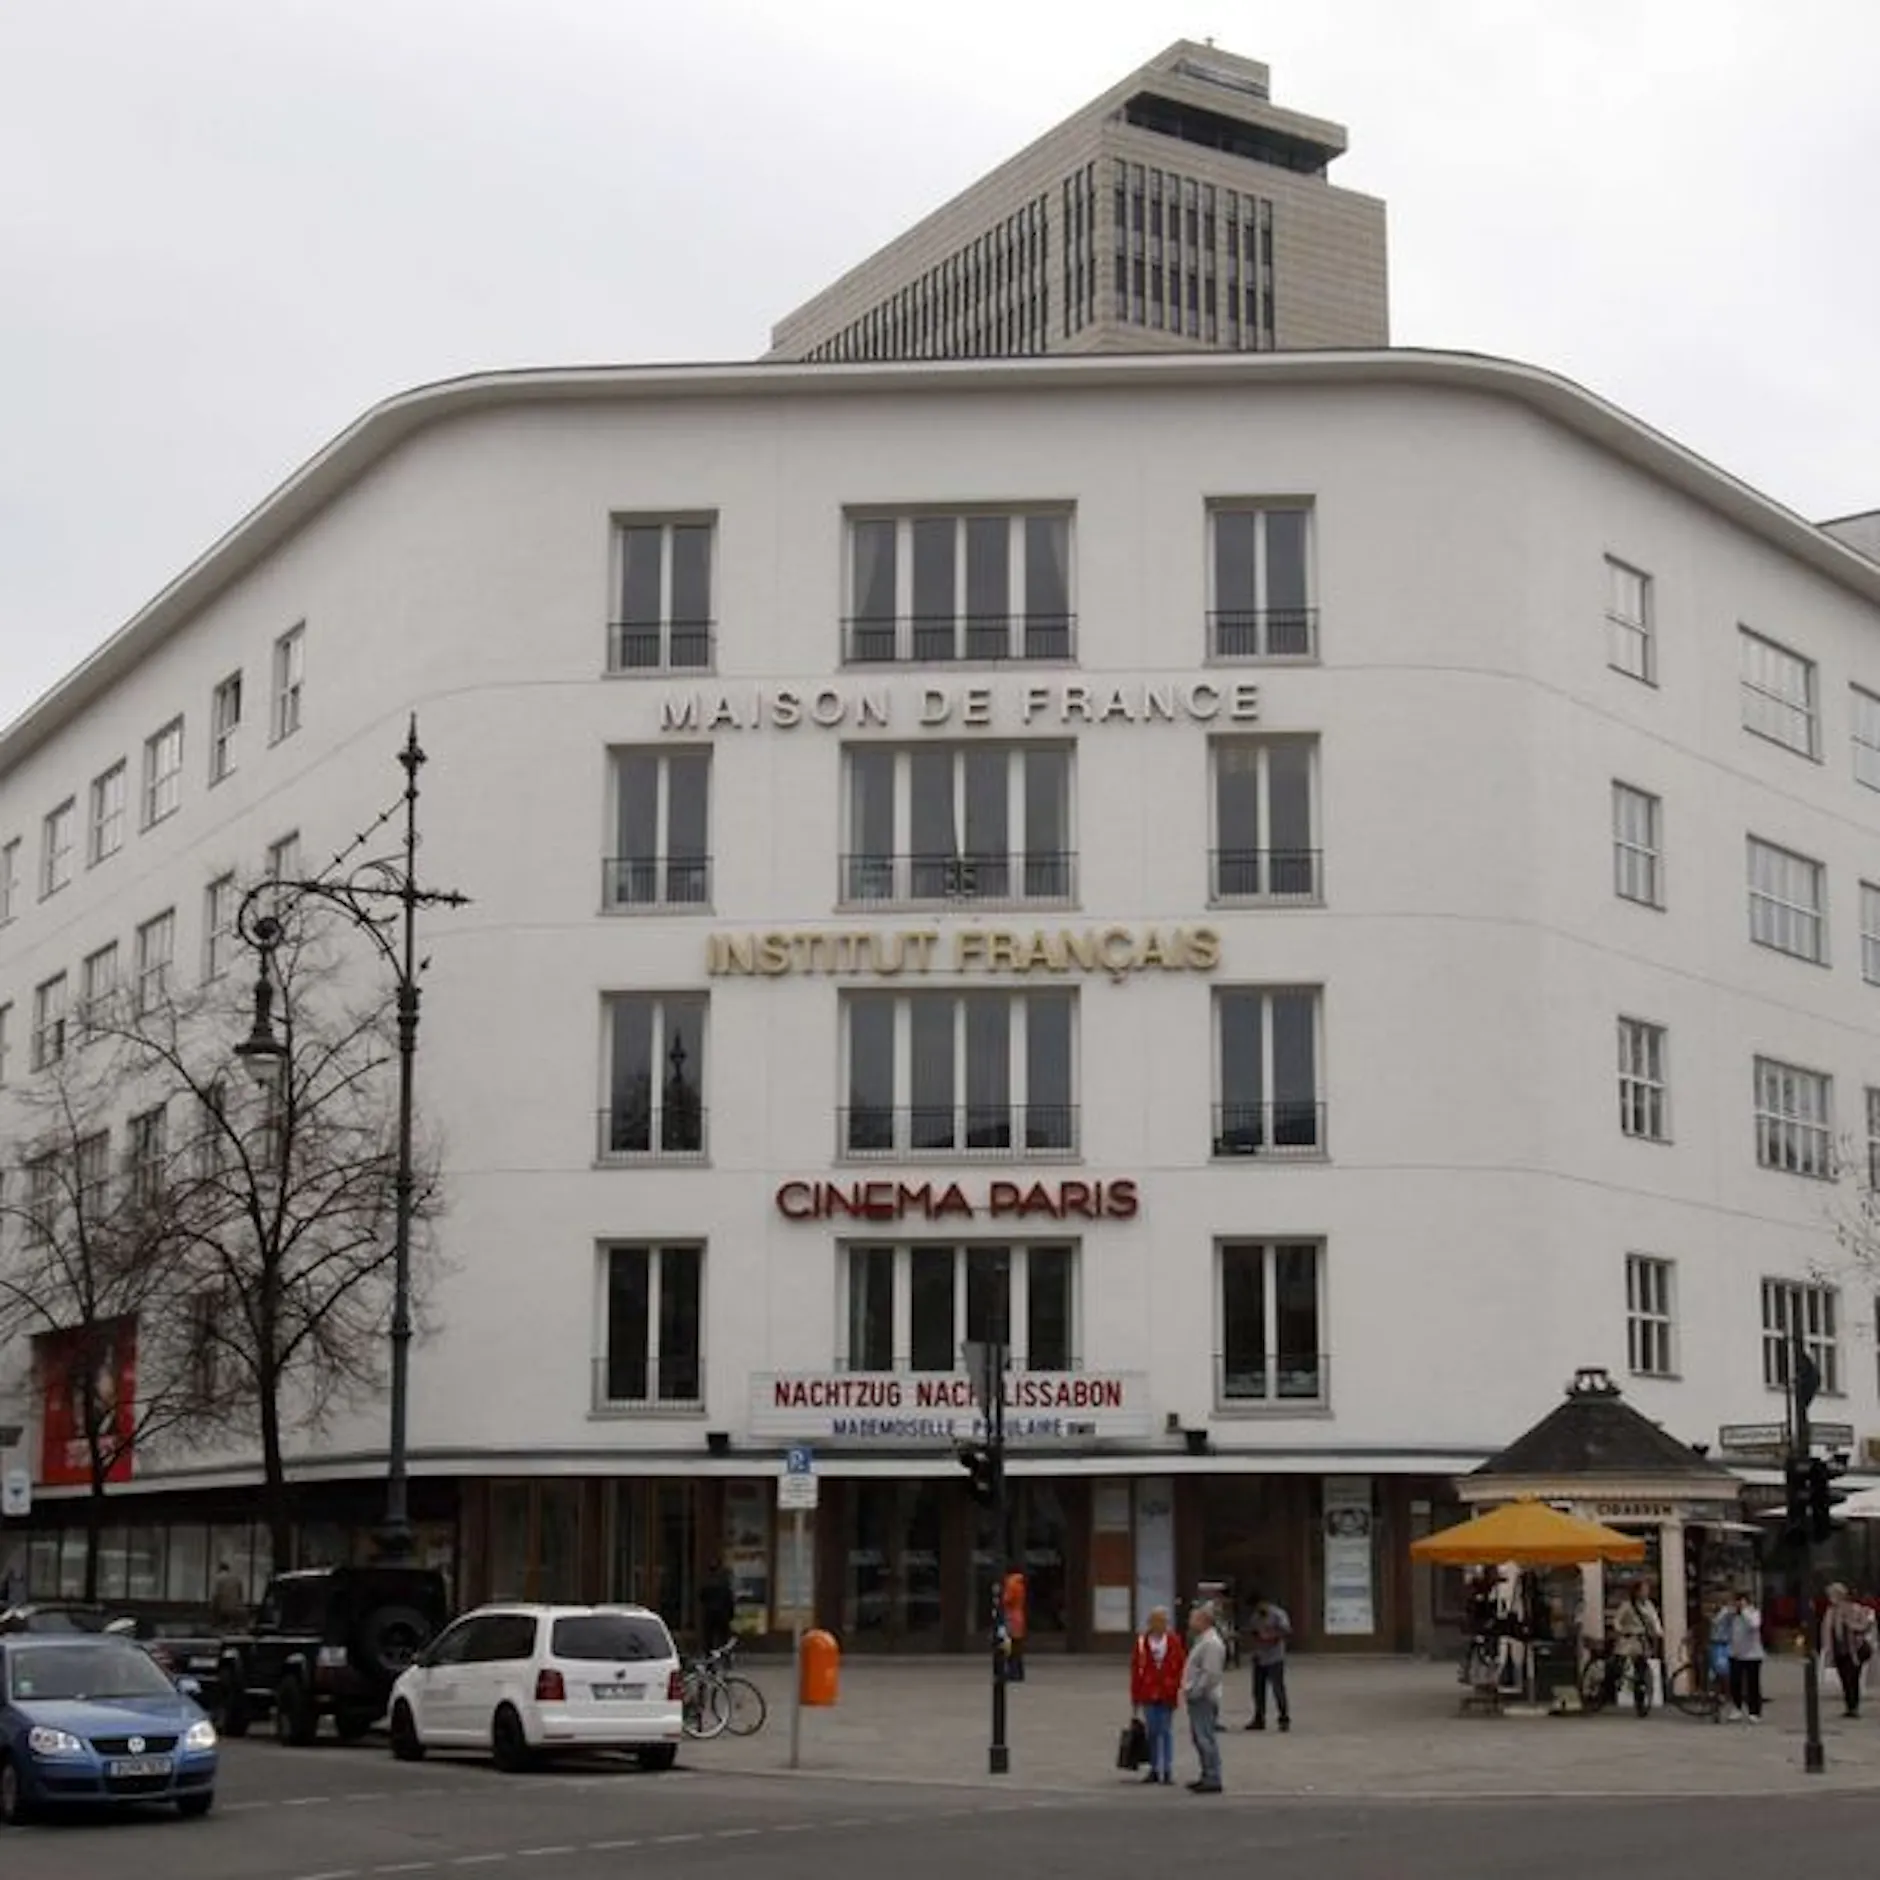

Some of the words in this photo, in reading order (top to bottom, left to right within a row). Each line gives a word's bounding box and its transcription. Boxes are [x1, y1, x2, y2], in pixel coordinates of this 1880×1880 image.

[660, 689, 889, 731] MAISON
[918, 689, 992, 727] DE
[1022, 684, 1260, 724] FRANCE
[706, 930, 940, 976] INSTITUT
[955, 926, 1221, 984] FRANÇAIS
[775, 1181, 974, 1220] CINEMA
[989, 1180, 1139, 1220] PARIS
[775, 1381, 901, 1407] NACHTZUG
[1002, 1379, 1123, 1407] LISSABON
[833, 1418, 955, 1437] MADEMOISELLE
